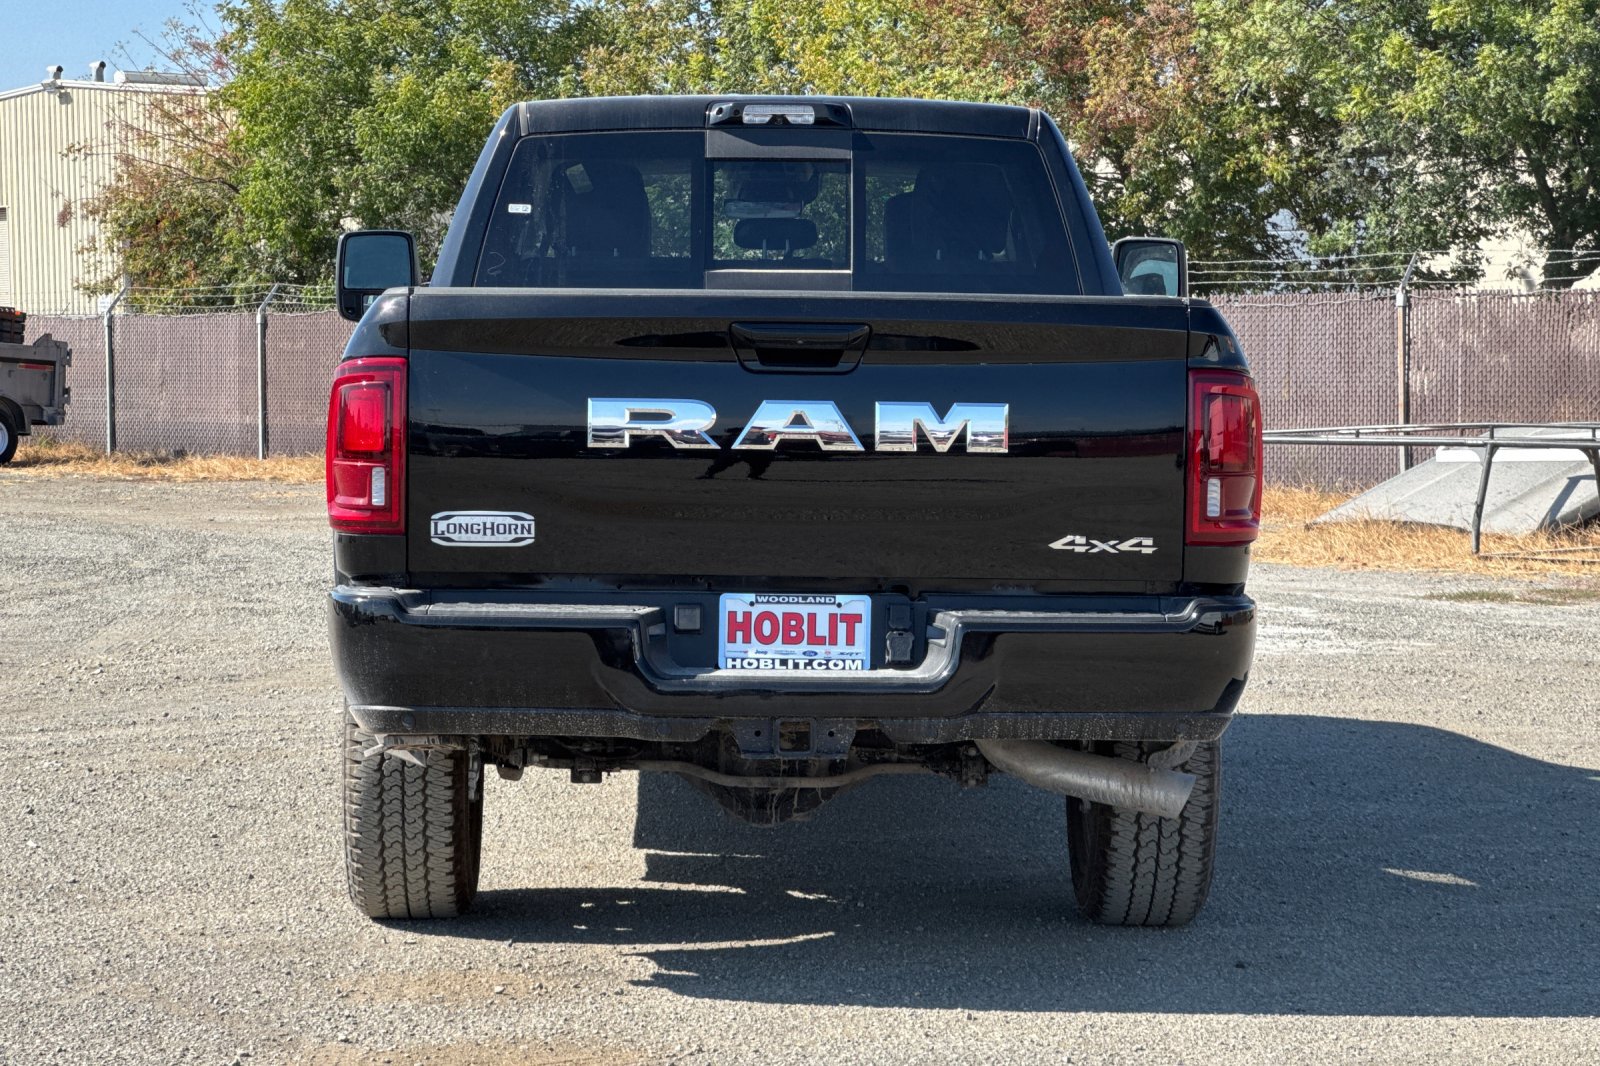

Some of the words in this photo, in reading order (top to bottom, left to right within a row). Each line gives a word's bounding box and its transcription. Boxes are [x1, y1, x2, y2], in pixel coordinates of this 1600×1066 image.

[588, 397, 1009, 453] RAM
[756, 595, 835, 603] WOODLAND
[727, 611, 862, 646] HOBLIT
[726, 658, 862, 670] HOBLIT.COM
